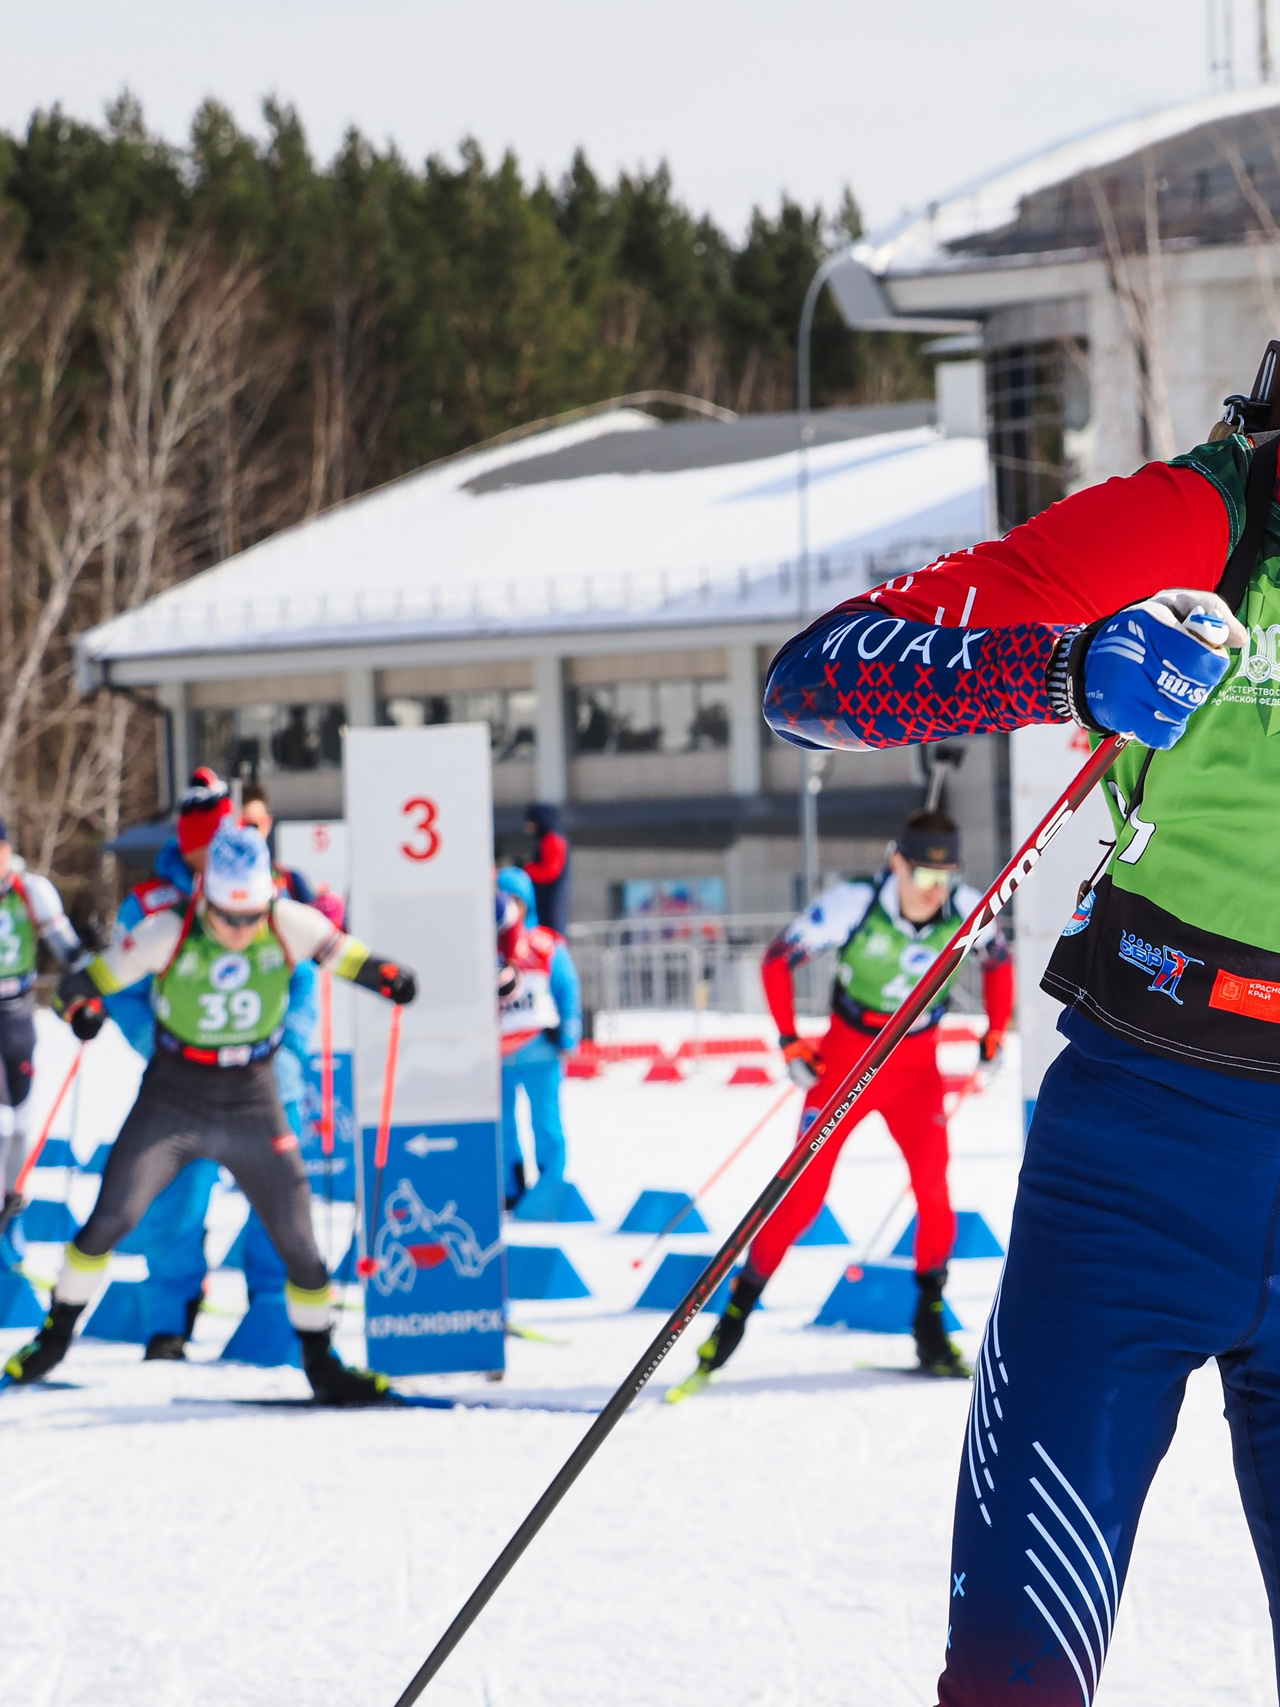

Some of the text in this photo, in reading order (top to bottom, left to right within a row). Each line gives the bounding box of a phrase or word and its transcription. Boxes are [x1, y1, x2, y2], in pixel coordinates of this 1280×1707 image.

[401, 798, 440, 860] 3
[197, 990, 261, 1032] 39
[1247, 990, 1272, 1001] КРАЙ
[847, 1066, 877, 1102] TRIAC
[809, 1117, 836, 1152] AERO
